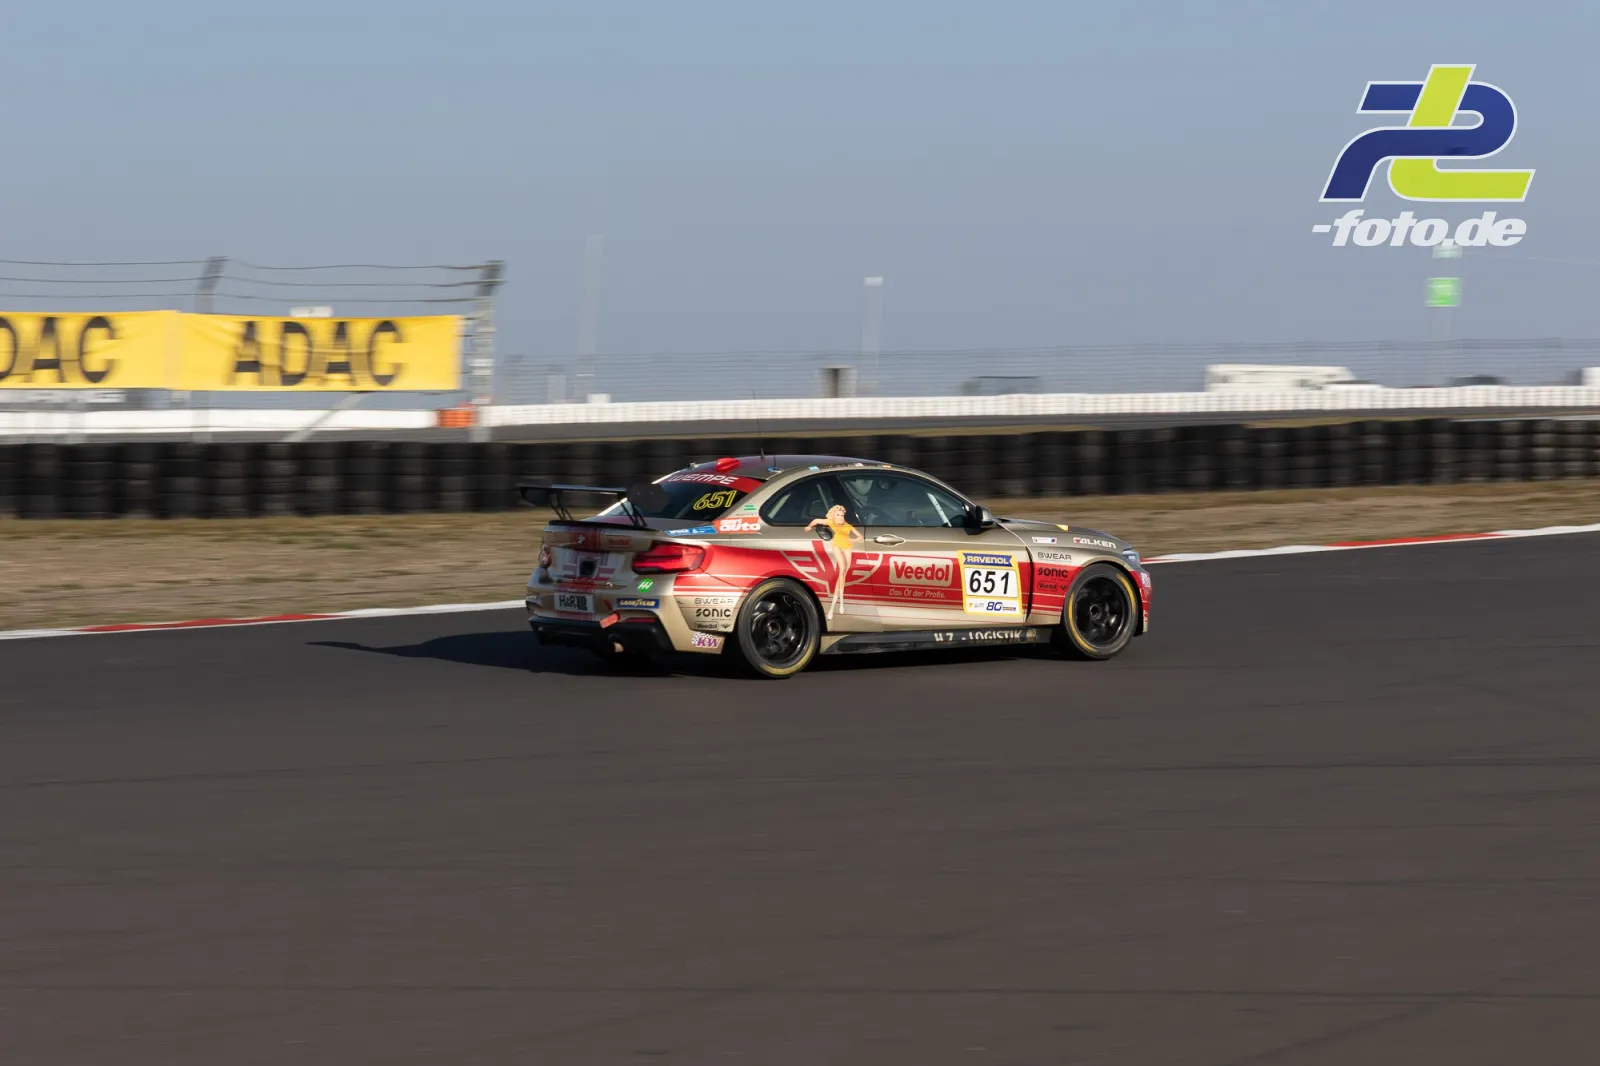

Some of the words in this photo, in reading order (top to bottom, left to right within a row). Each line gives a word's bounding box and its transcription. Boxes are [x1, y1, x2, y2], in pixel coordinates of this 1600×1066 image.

[230, 320, 404, 385] ADAC
[668, 473, 739, 485] WEMPE
[693, 490, 738, 511] 651
[719, 522, 761, 532] auto
[1073, 536, 1116, 549] FALKEN
[967, 556, 1009, 565] RAVENOL
[893, 561, 950, 581] Veedol
[1038, 567, 1068, 578] SONIC
[969, 570, 1010, 594] 651
[889, 588, 902, 596] Das
[913, 589, 924, 597] der
[619, 599, 657, 607] GOODYEAR
[695, 608, 732, 618] SONIC
[696, 637, 721, 648] KW
